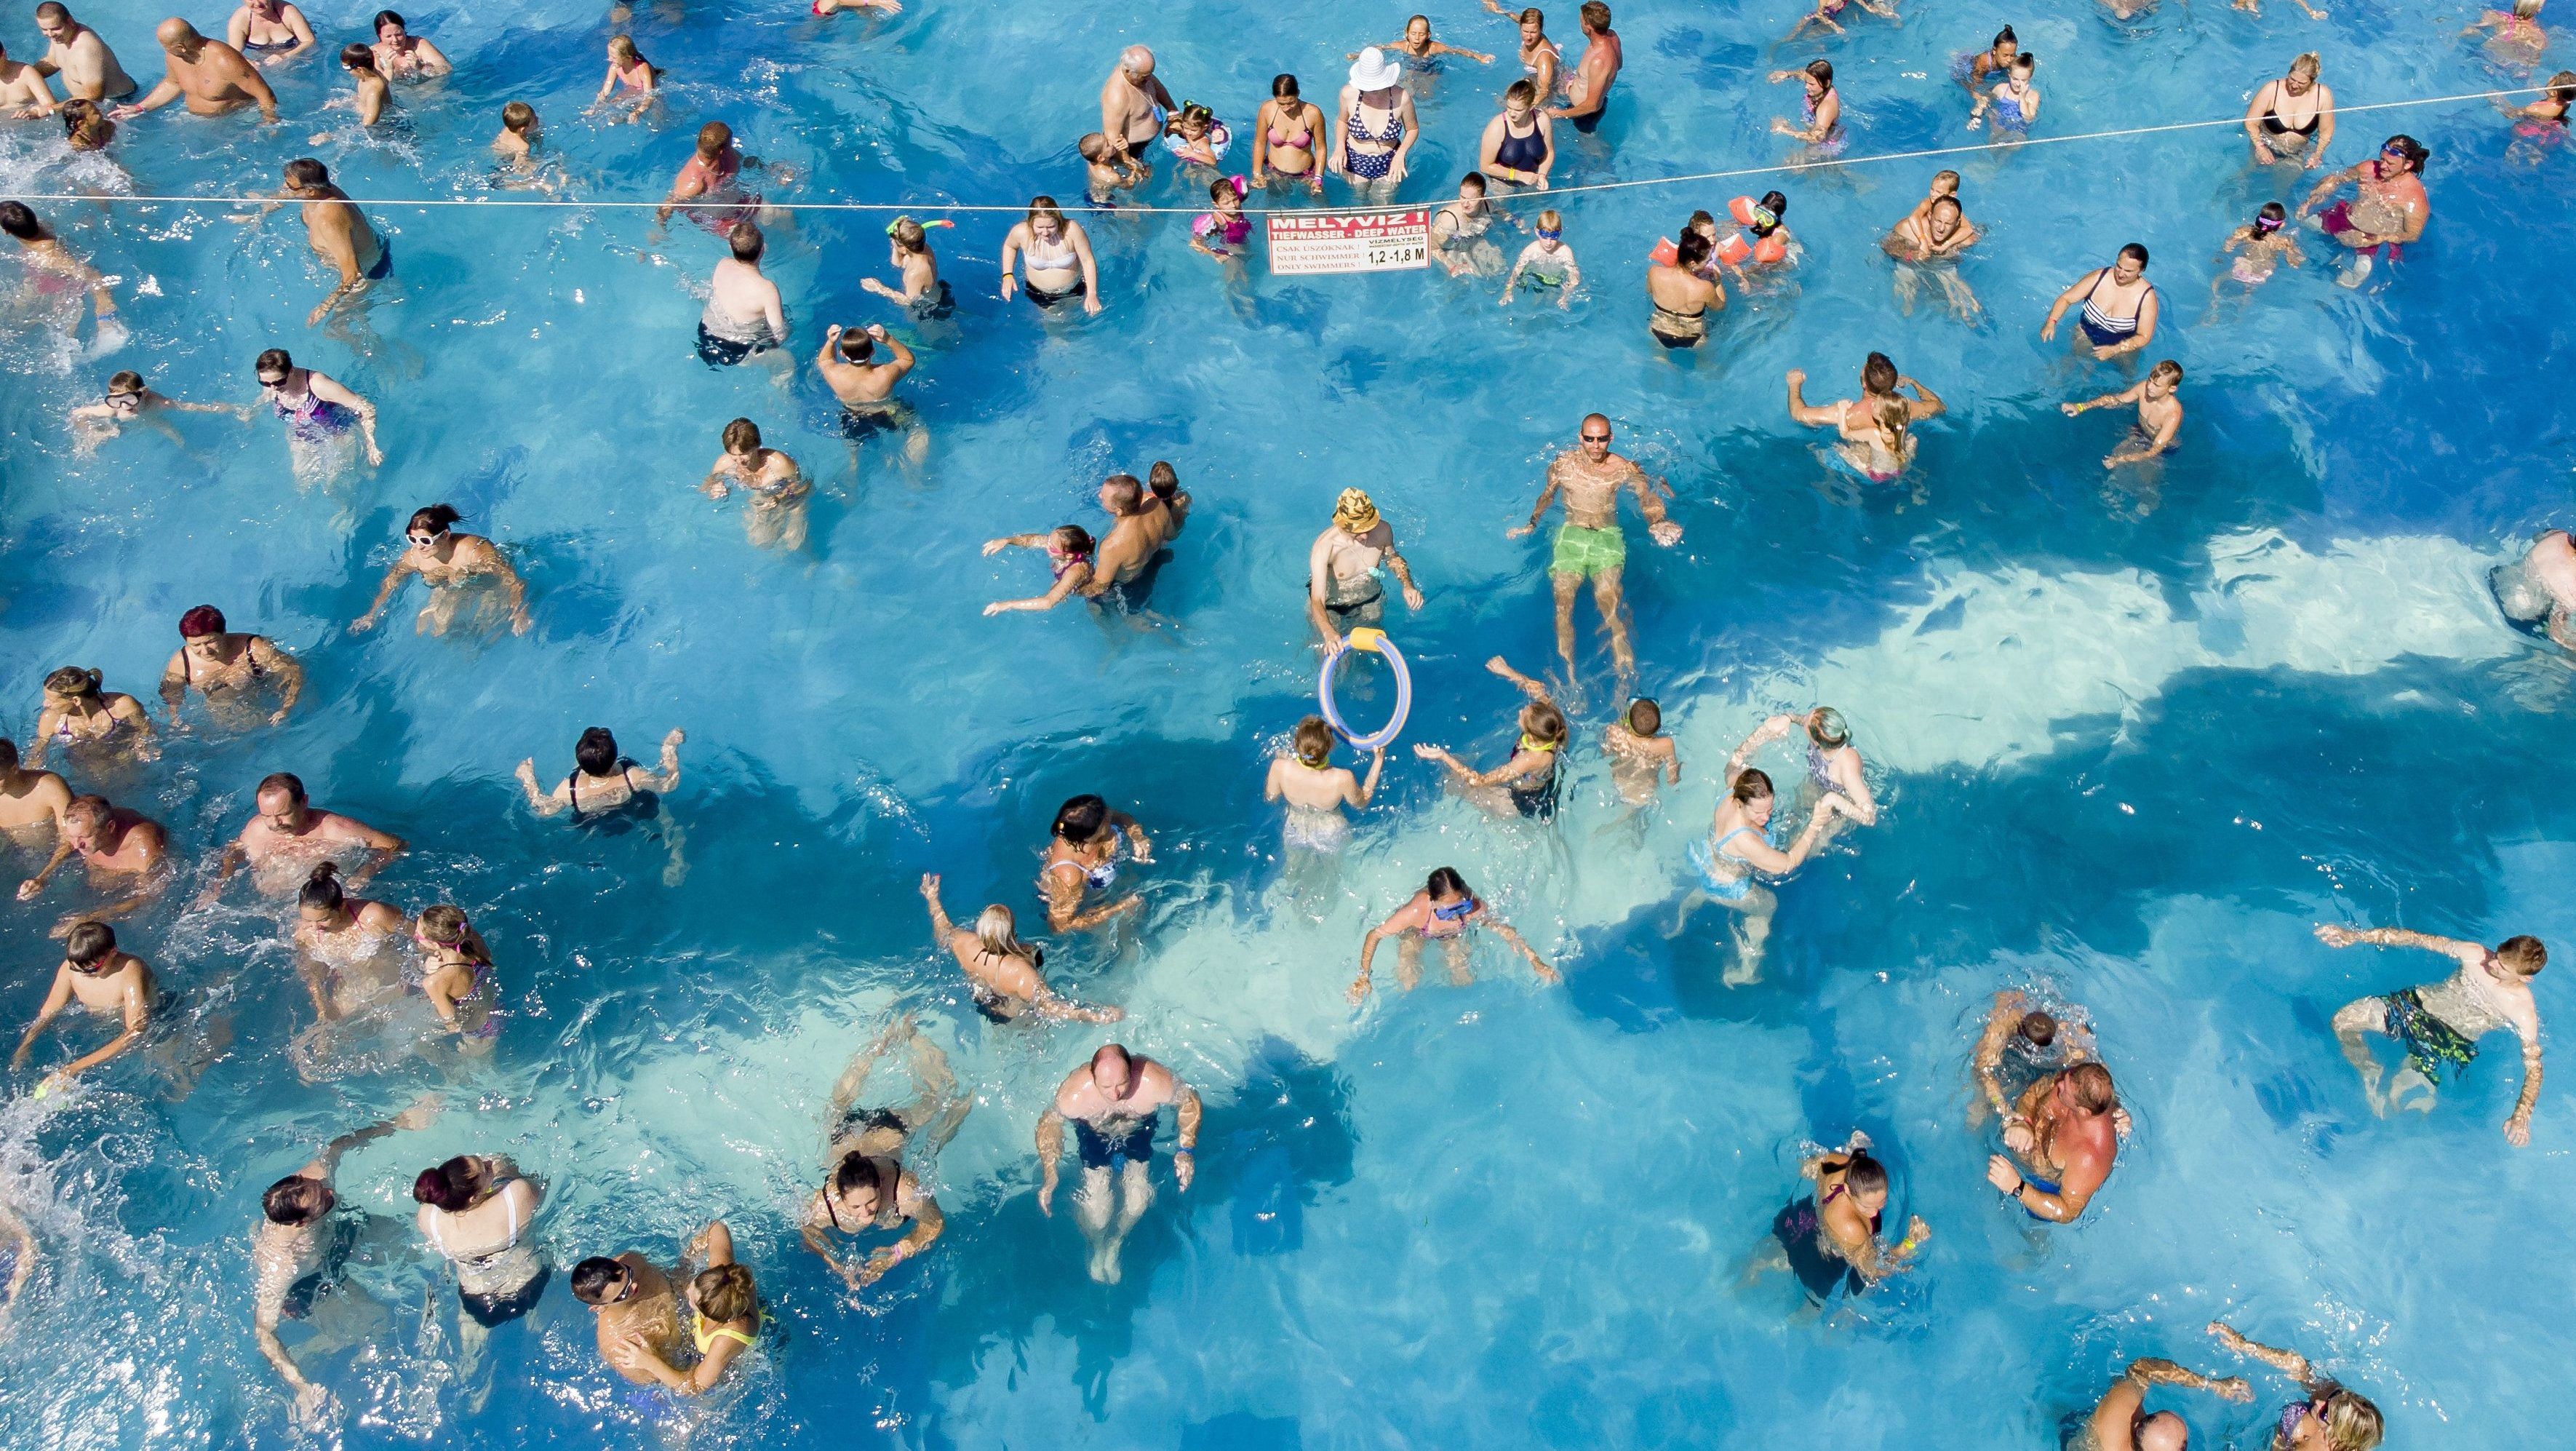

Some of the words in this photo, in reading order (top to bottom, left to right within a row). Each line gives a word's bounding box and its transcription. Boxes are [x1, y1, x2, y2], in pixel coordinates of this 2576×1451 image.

[1416, 212, 1424, 223] !
[1272, 230, 1345, 240] TIEFWASSER
[1355, 228, 1384, 238] DEEP
[1387, 224, 1427, 236] WATER
[1300, 253, 1360, 261] SCHWIMMER
[1368, 250, 1385, 266] 1,2
[1415, 248, 1424, 260] M
[1304, 262, 1355, 270] SWIMMERS
